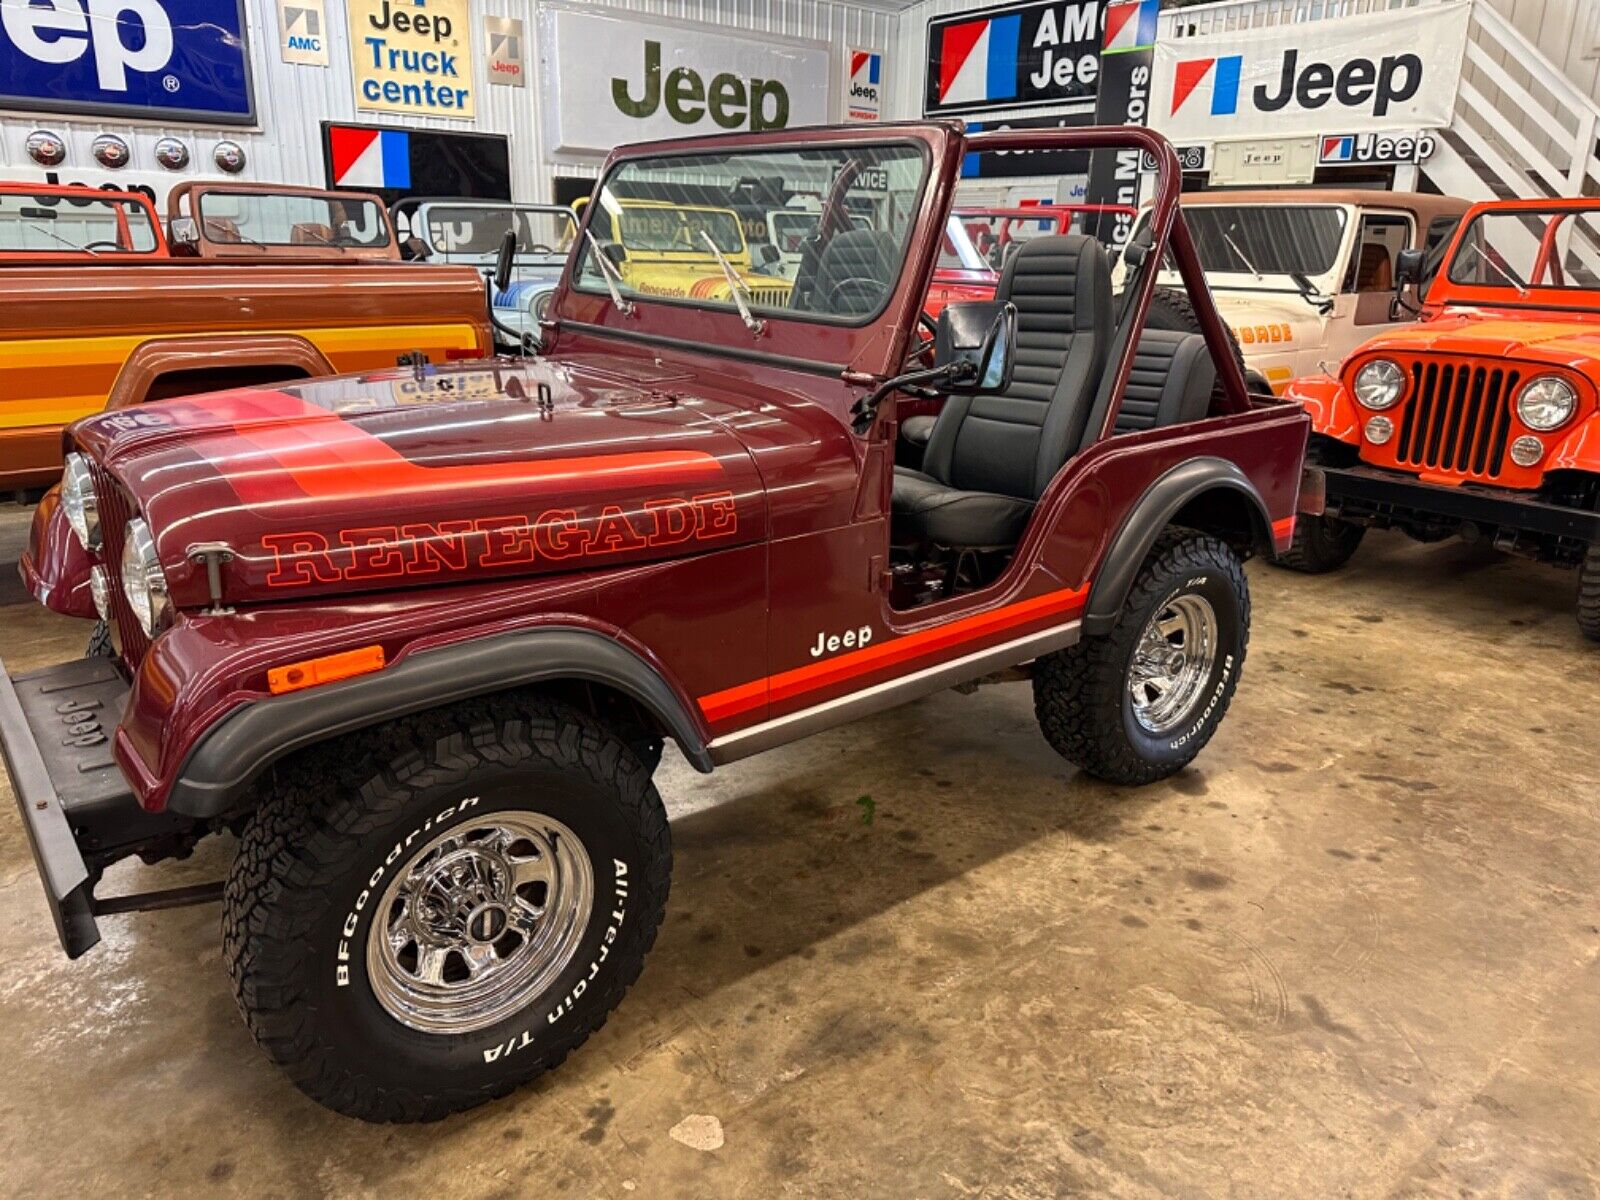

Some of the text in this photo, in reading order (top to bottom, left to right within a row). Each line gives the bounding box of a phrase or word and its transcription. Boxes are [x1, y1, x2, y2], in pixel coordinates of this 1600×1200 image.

[369, 1, 451, 42] Jeep
[1033, 1, 1104, 47] AM
[288, 36, 320, 51] AMC
[365, 37, 458, 77] Truck
[491, 60, 520, 75] Jeep
[612, 40, 789, 131] Jeep
[1030, 51, 1099, 89] Jee
[1253, 49, 1423, 116] Jeep
[363, 79, 468, 109] center
[851, 82, 877, 101] Jeep
[1244, 153, 1281, 165] Jeep
[1356, 134, 1434, 165] Jeep
[262, 491, 737, 587] RENEGADE
[810, 624, 873, 657] Jeep
[1171, 654, 1233, 750] BFGoodrich
[56, 700, 109, 748] Jeep
[336, 796, 480, 987] BFGoodrich
[483, 858, 628, 1063] All-Terrain T/A
